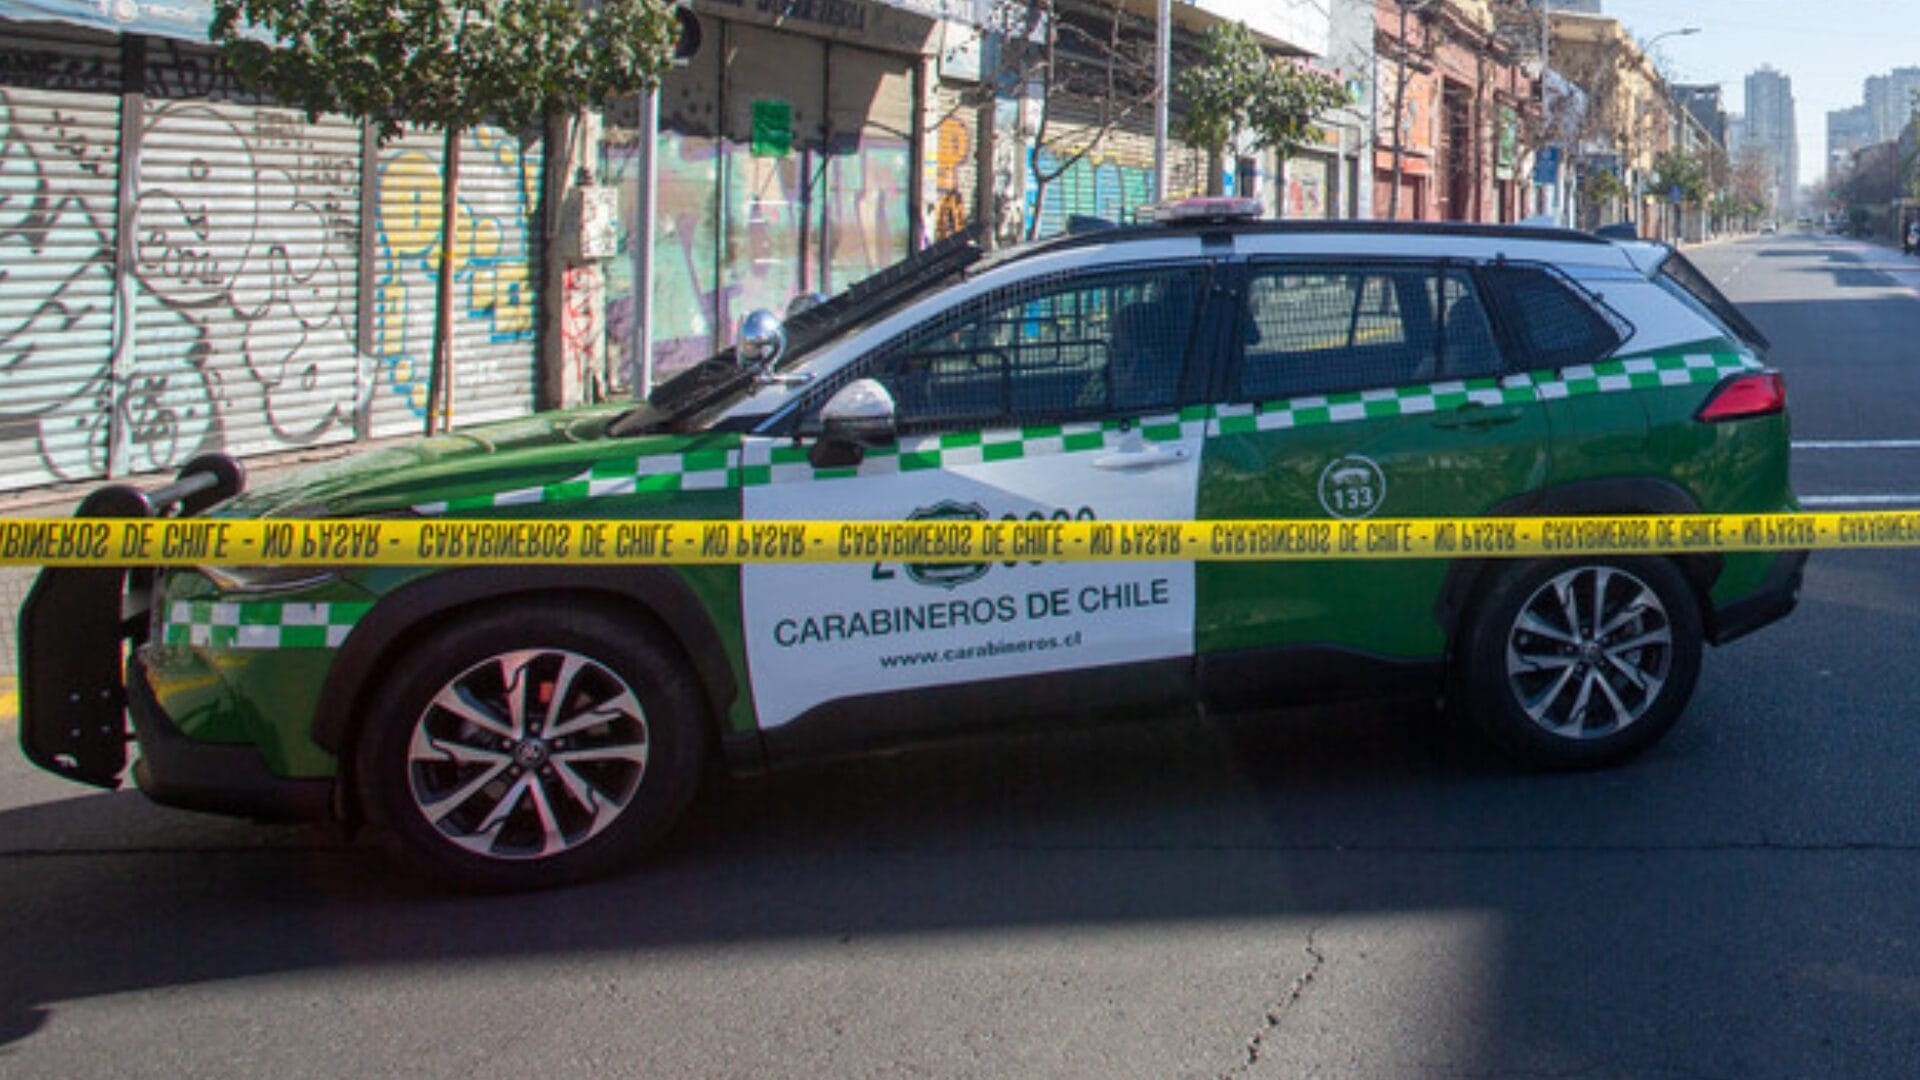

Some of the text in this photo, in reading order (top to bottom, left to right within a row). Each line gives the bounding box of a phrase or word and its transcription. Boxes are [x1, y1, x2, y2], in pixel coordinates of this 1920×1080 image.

[1334, 486, 1373, 509] 133
[773, 578, 1169, 648] CARABINEROS DE CHILE
[879, 630, 1083, 669] www.carabineros.cl
